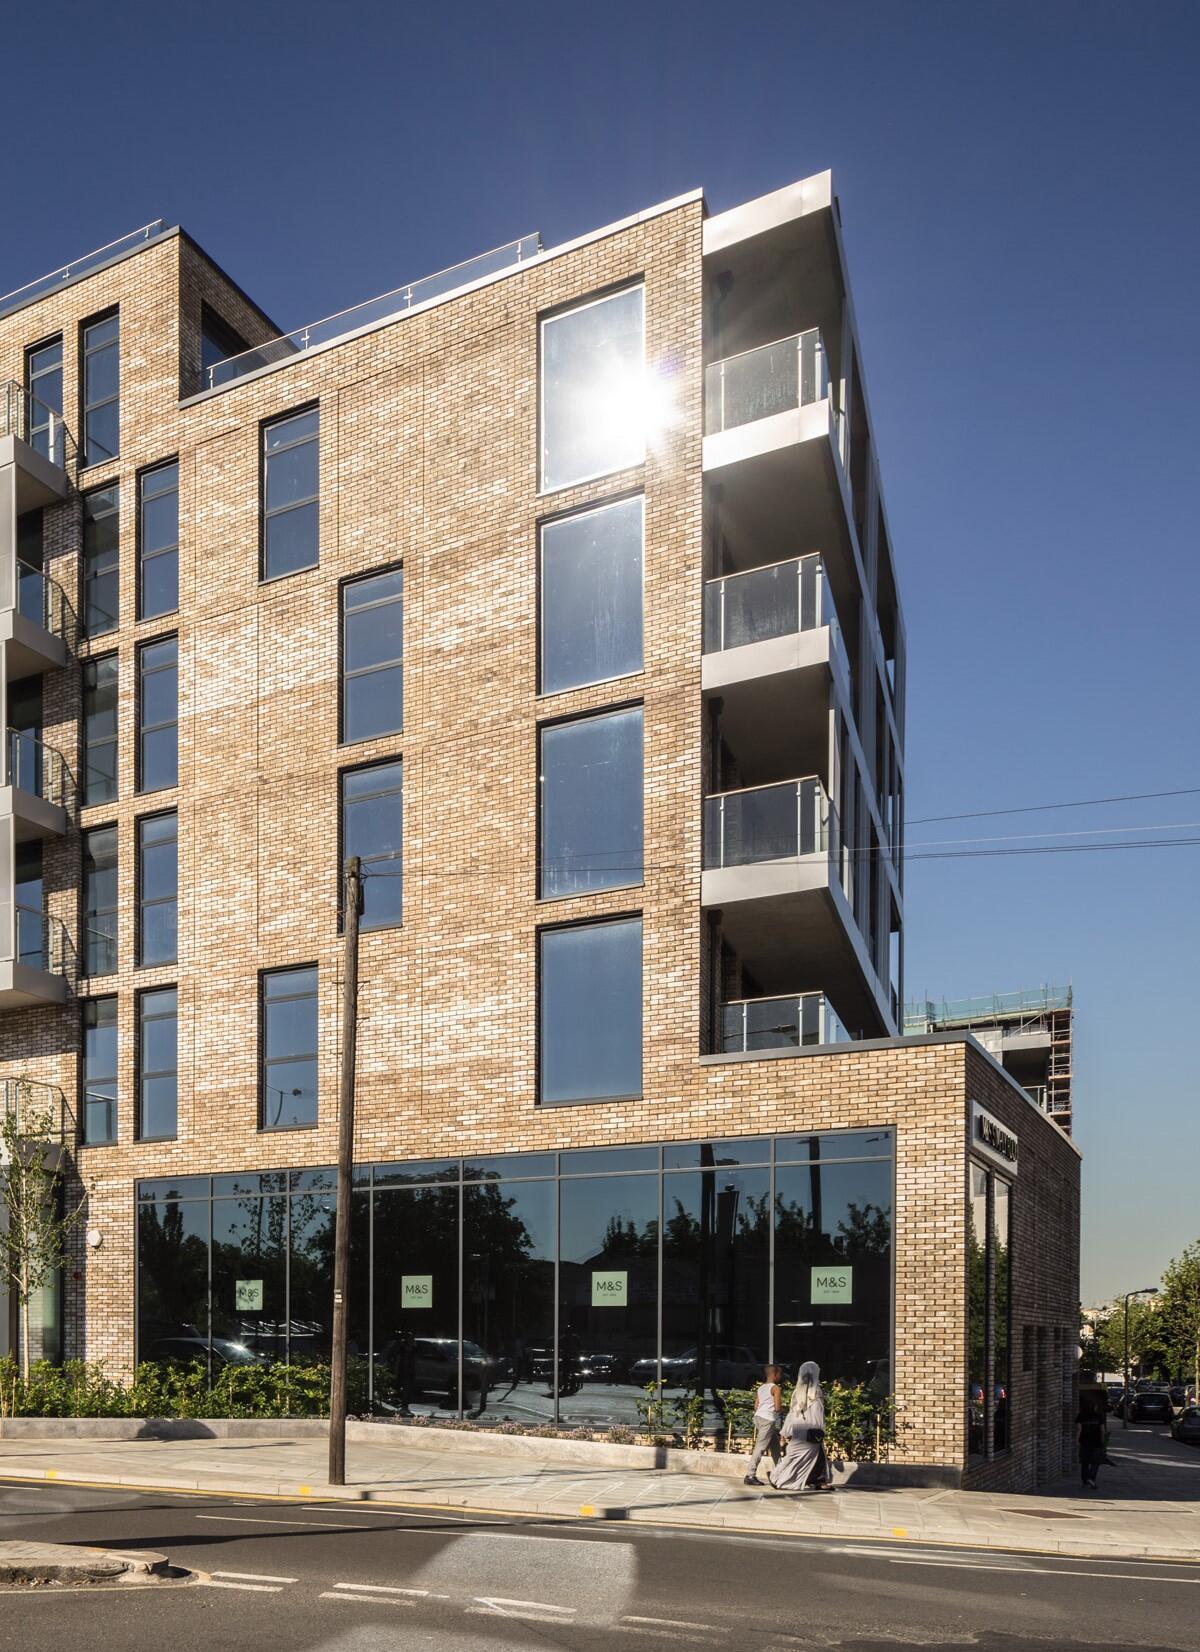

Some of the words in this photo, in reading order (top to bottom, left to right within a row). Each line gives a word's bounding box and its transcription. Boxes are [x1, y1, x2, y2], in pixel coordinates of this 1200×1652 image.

[597, 1281, 623, 1291] M&S
[816, 1277, 846, 1288] M&S
[405, 1285, 428, 1294] M&S
